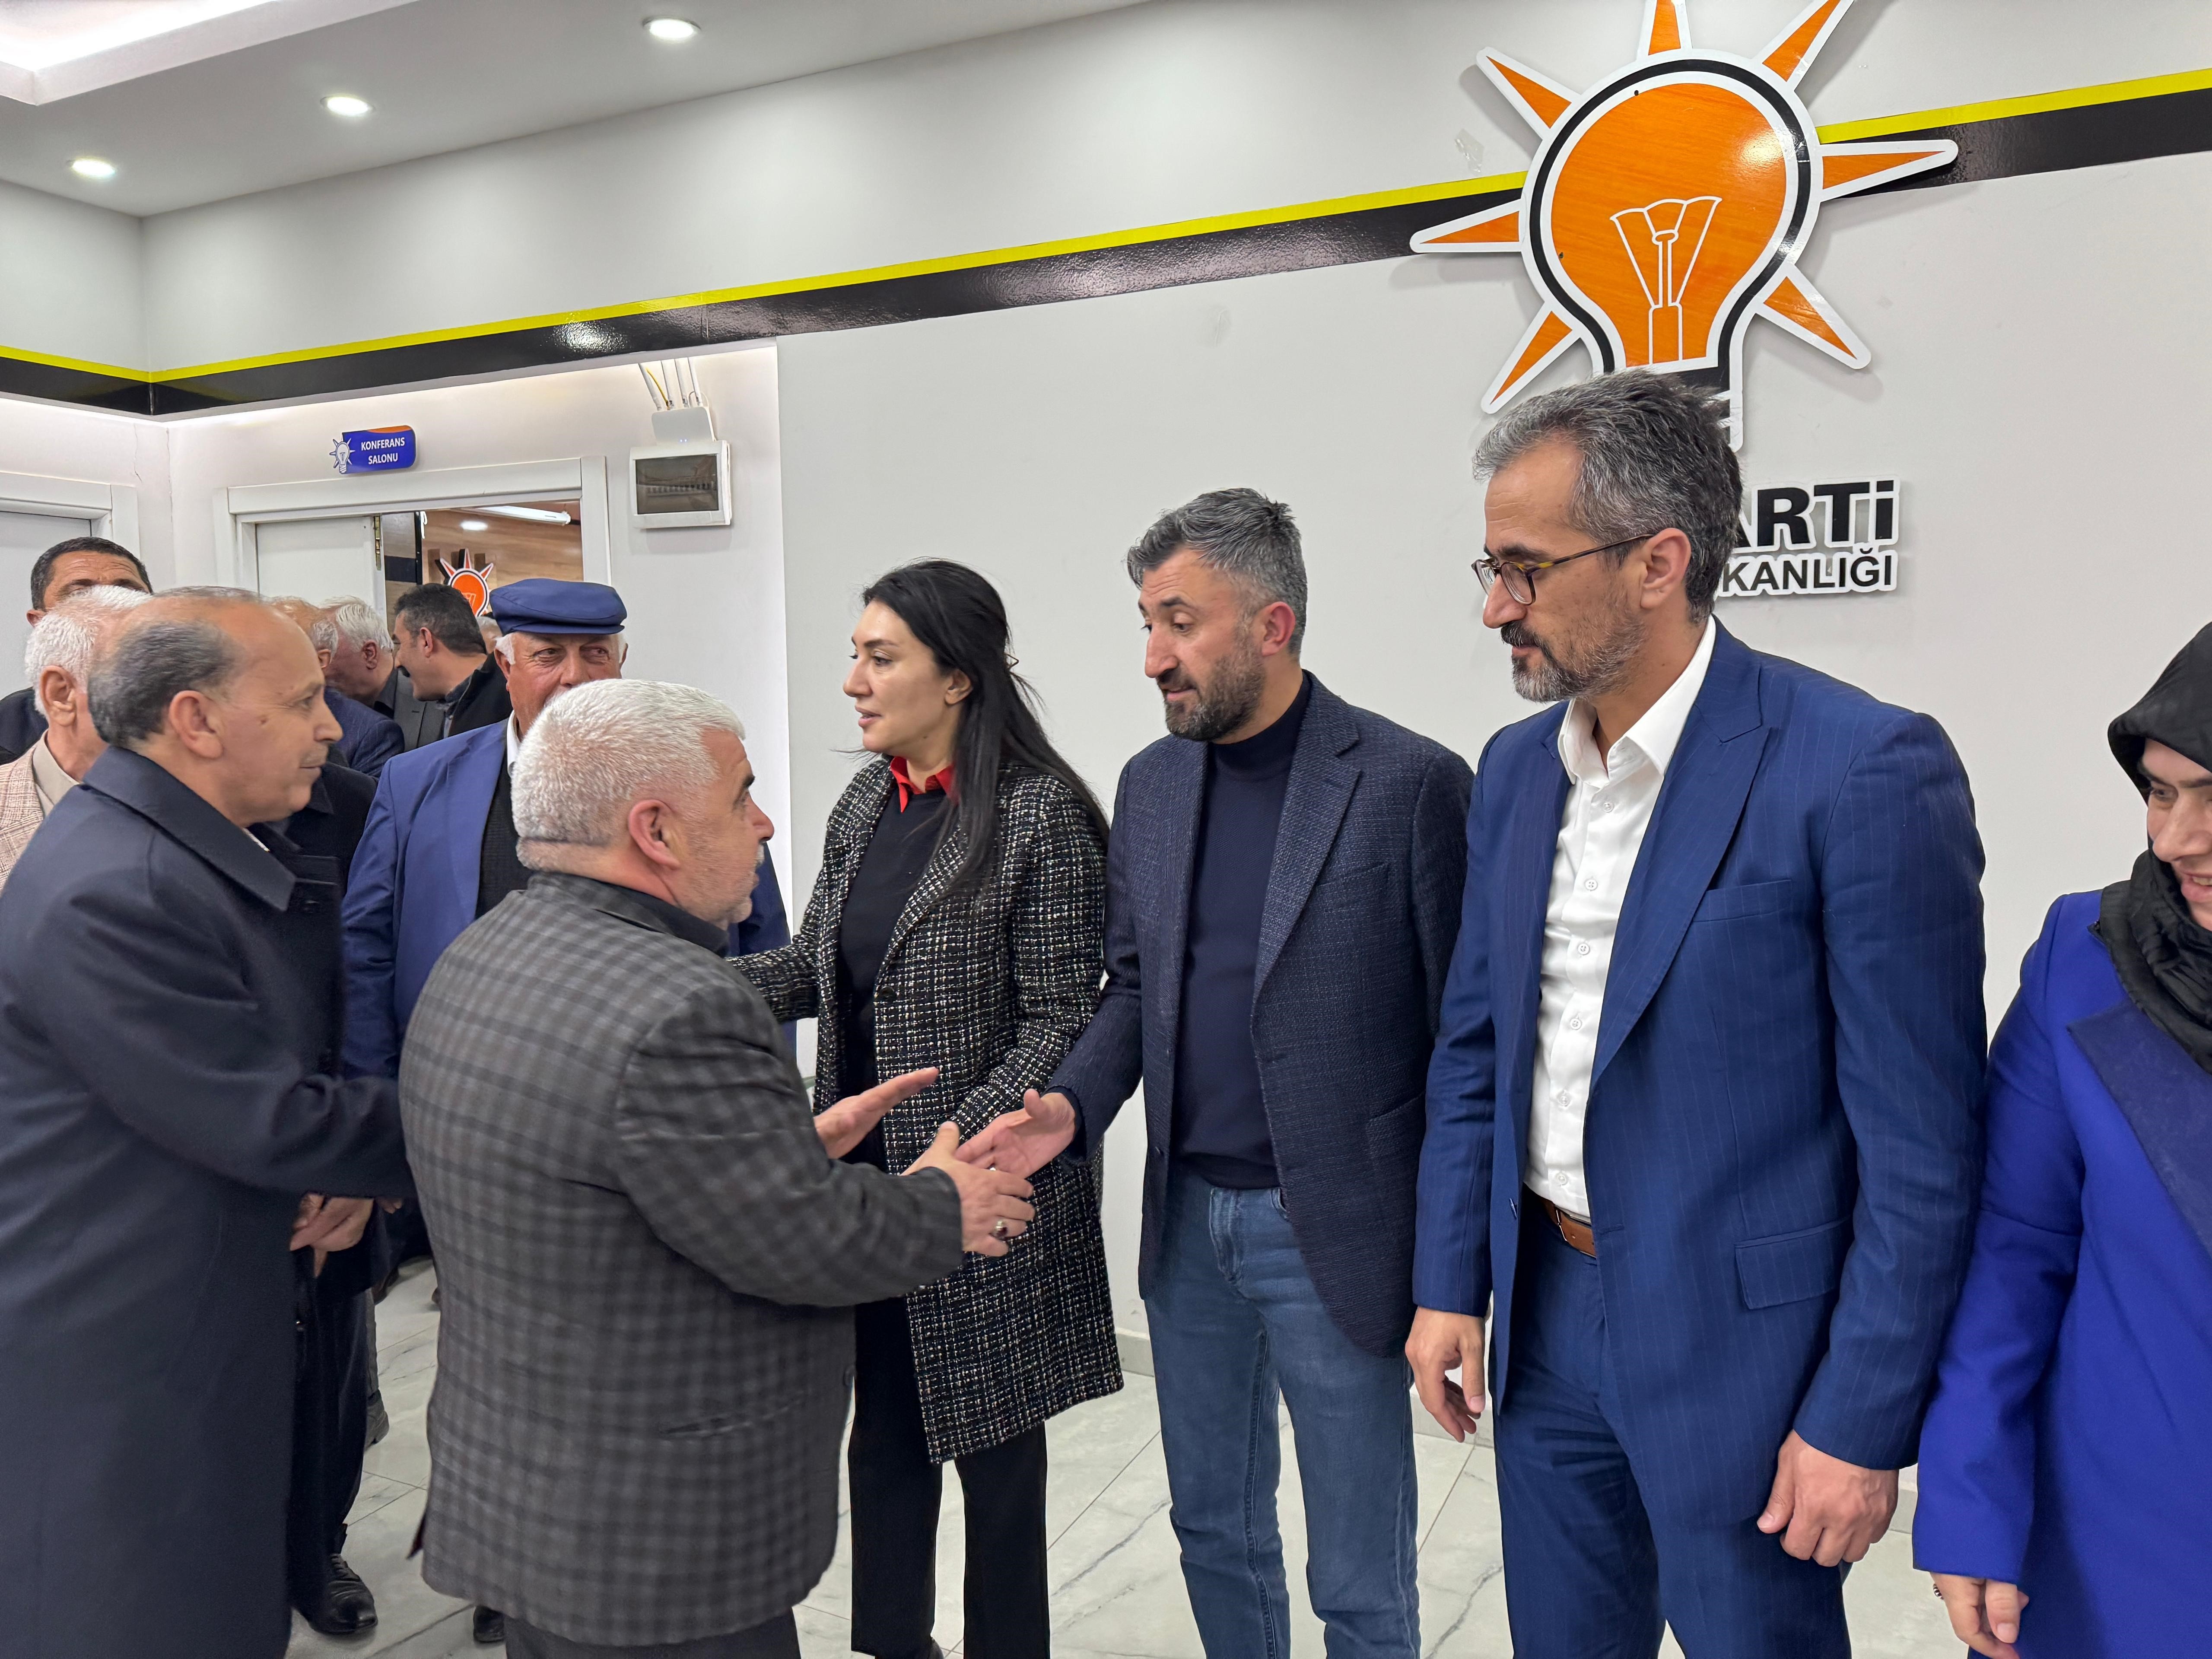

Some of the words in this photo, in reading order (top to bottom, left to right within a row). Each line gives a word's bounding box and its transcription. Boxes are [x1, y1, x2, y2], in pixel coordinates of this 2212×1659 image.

[361, 437, 405, 451] KONFERANS
[368, 453, 398, 464] SALONU
[1723, 547, 1891, 592] KANLIĞI
